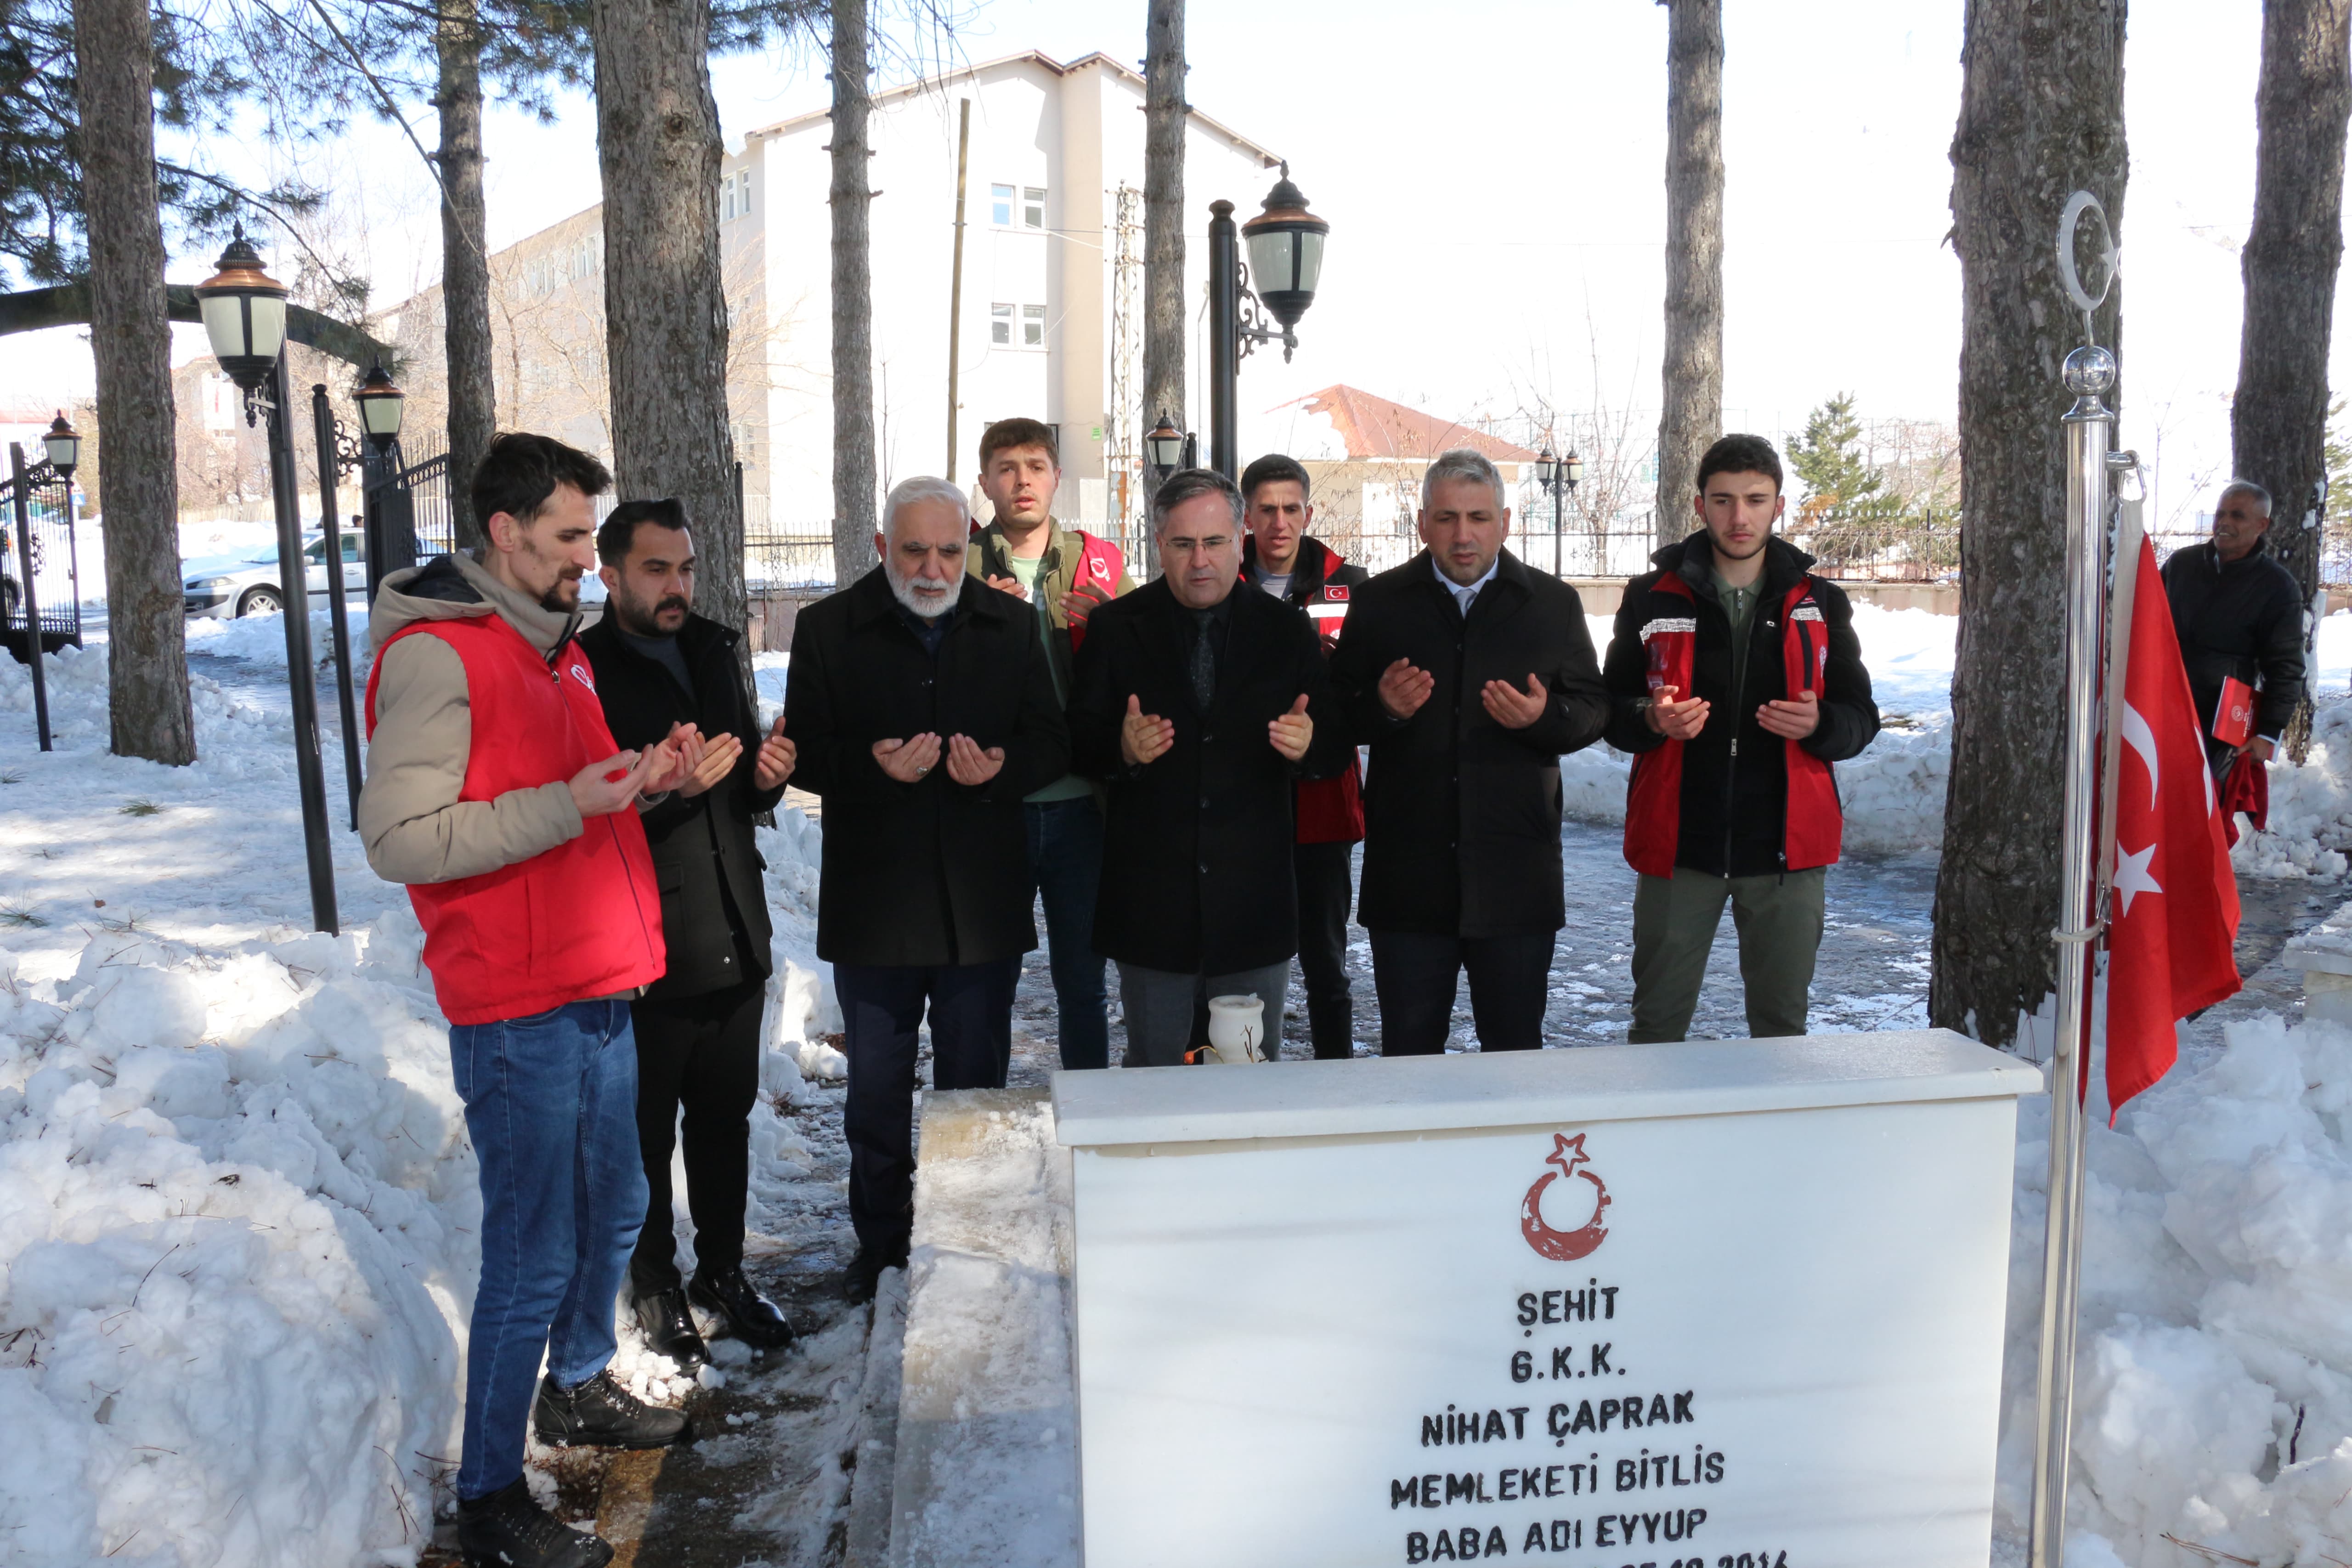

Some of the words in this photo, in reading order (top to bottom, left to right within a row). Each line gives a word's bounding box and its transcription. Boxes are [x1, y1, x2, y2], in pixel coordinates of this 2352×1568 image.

[1517, 1277, 1620, 1337] ŞEHİT
[1420, 1404, 1530, 1448] NİHAT
[1546, 1390, 1695, 1448] ÇAPRAK
[1391, 1452, 1599, 1510] MEMLEKETİ
[1615, 1443, 1725, 1492] BİTLİS
[1406, 1525, 1508, 1565] BABA
[1523, 1519, 1582, 1554] ADI
[1594, 1508, 1707, 1548] EYYUP
